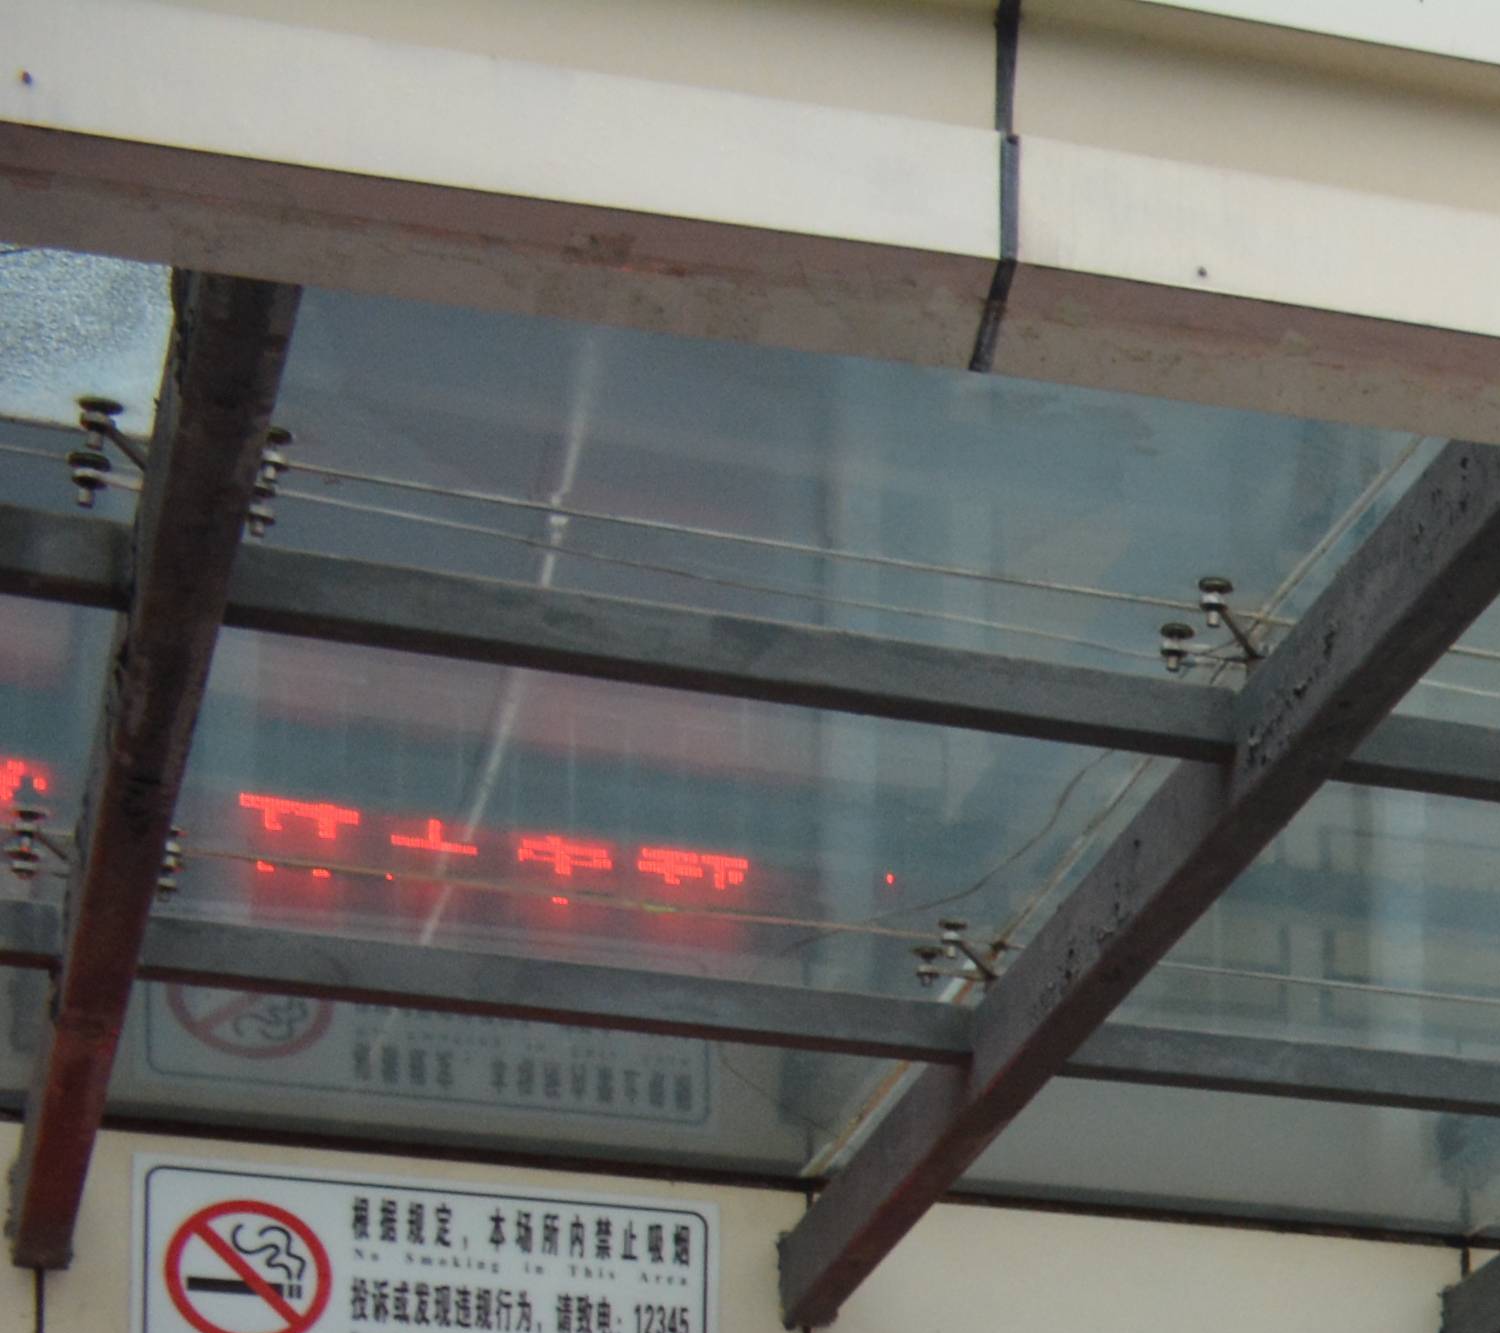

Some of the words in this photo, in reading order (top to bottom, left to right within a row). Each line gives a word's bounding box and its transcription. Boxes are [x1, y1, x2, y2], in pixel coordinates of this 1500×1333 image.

[352, 1197, 690, 1266] 根据规定，本场所内禁止吸烟
[405, 1251, 501, 1274] Smoking
[570, 1264, 617, 1280] This
[640, 1272, 688, 1286] Area
